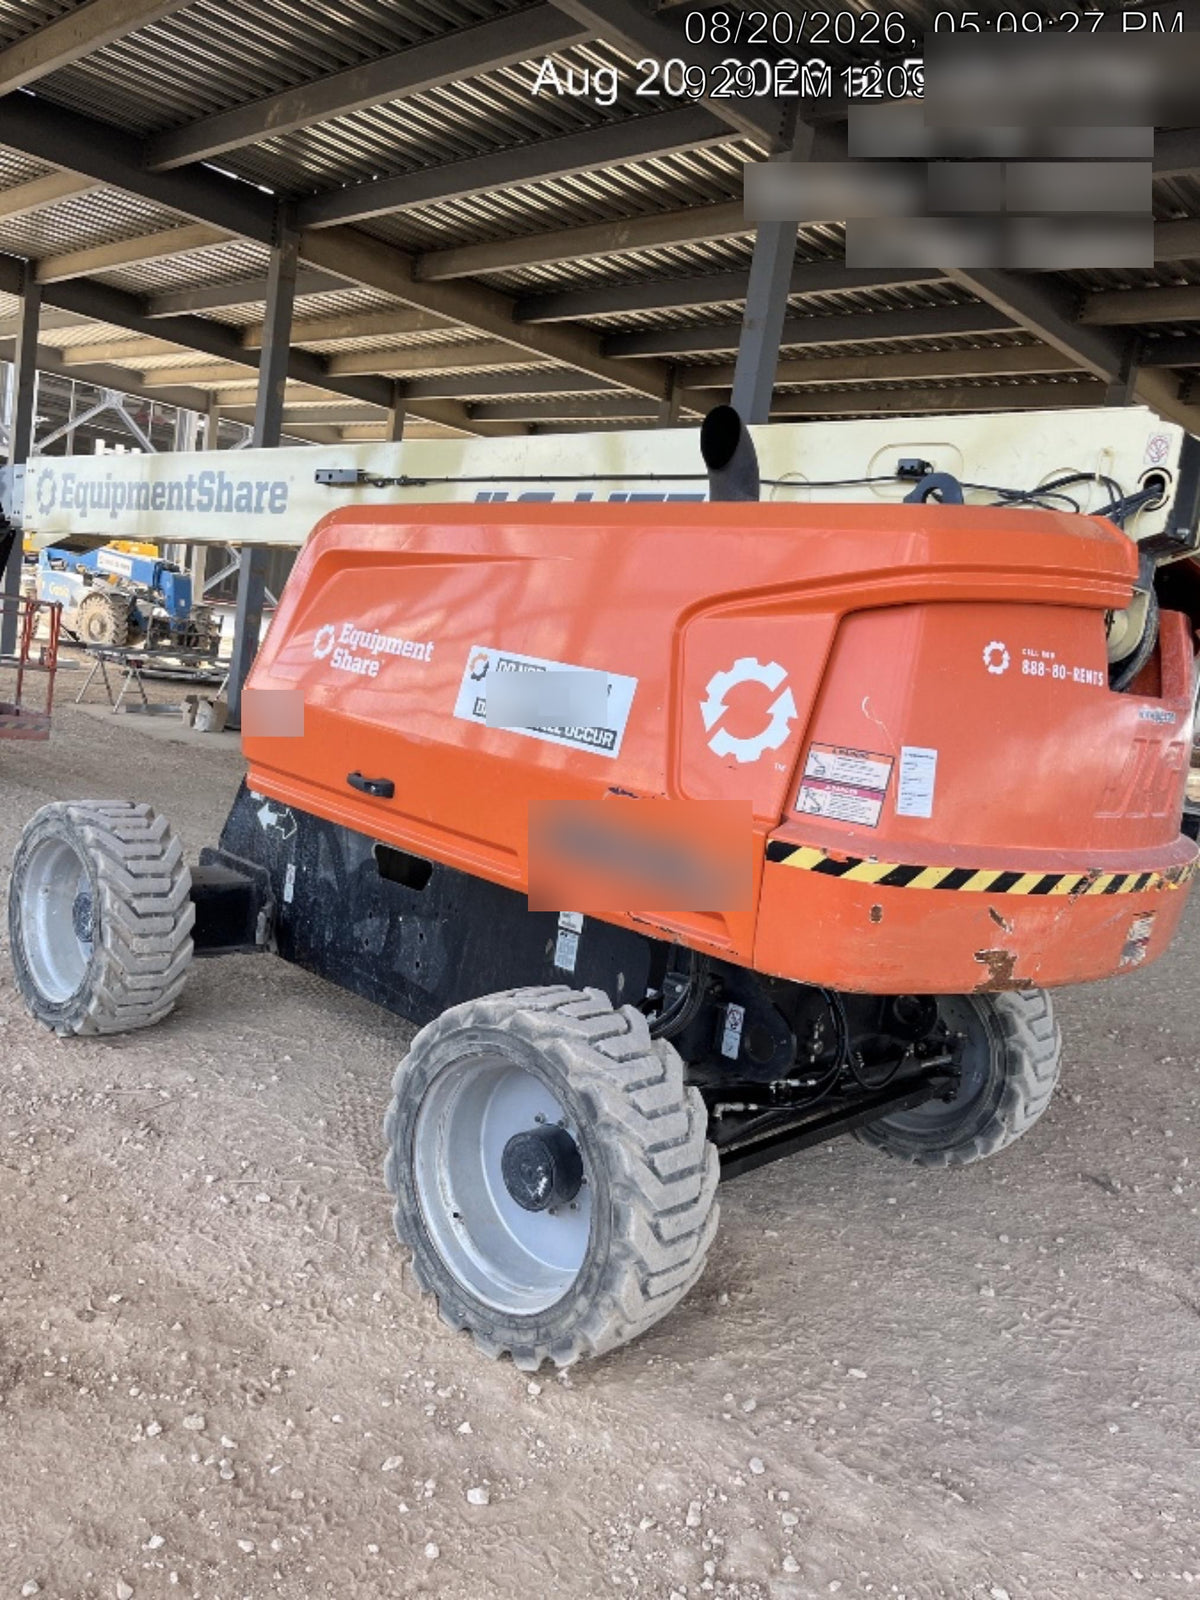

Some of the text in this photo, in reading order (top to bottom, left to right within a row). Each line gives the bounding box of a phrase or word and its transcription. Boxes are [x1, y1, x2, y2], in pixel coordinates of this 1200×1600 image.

[59, 471, 289, 519] EquipmentShare
[337, 622, 435, 663] Equipment
[330, 653, 381, 677] Share
[1022, 659, 1104, 687] 888-80-RENTS
[564, 727, 615, 748] OCCUR
